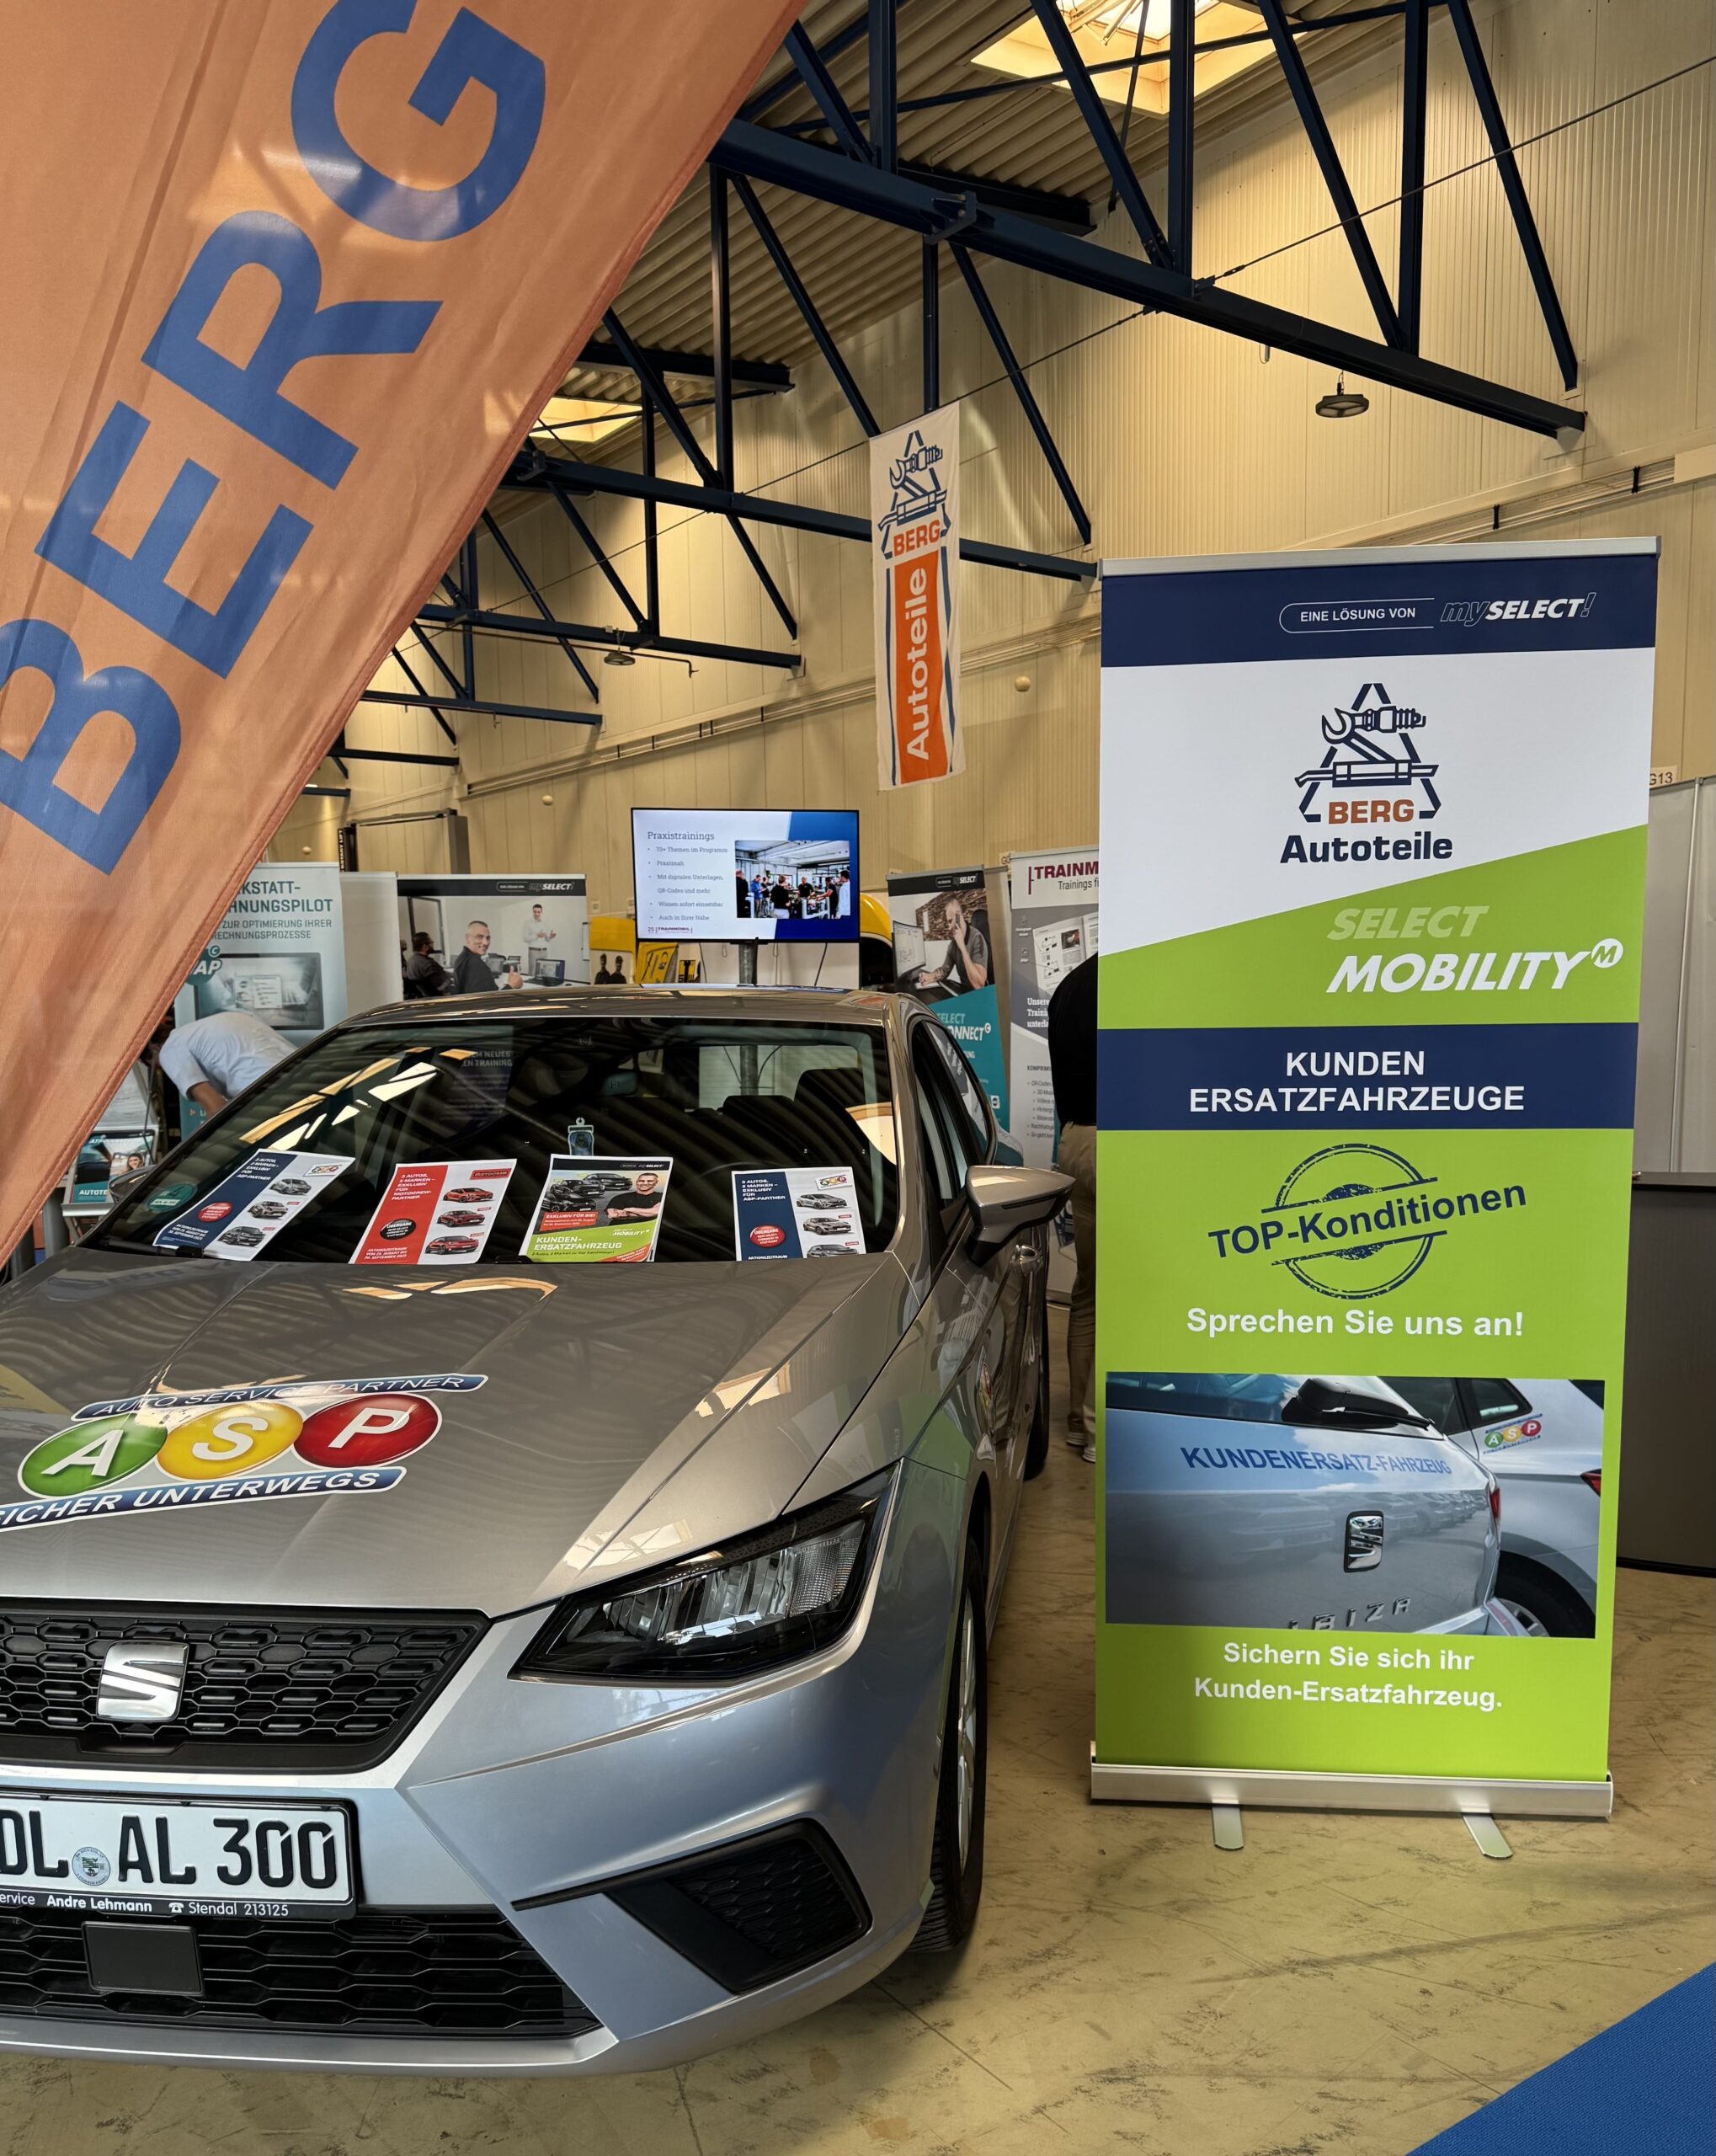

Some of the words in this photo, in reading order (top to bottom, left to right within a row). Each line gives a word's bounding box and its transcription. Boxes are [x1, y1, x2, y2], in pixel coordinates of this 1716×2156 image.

[0, 0, 546, 876] BERG
[893, 520, 941, 557] BERG
[1300, 611, 1329, 622] EINE
[1332, 608, 1386, 622] LÖSUNG
[1389, 607, 1416, 619] VON
[905, 566, 929, 760] Autoteile
[1328, 799, 1415, 825] BERG
[647, 831, 714, 841] Praxistrainings
[1281, 831, 1453, 864] Autoteile
[239, 881, 301, 894] KSTATT-
[1058, 879, 1092, 891] Trainings
[229, 899, 333, 913] HNUNGSPILOT
[213, 931, 312, 940] RECHNUNGSPROZESSE
[242, 920, 302, 928] OPTIMIERUNG
[305, 919, 332, 927] IHRER
[1327, 905, 1490, 940] SELECT
[1326, 951, 1592, 993] MOBILITY
[947, 1025, 984, 1041] ONNECT
[1286, 1050, 1426, 1078] KUNDEN
[1190, 1086, 1525, 1113] ERSATZFAHRZEUGE
[1207, 1180, 1527, 1259] TOP-Konditionen
[534, 1242, 622, 1251] ERSATZFAHRZEUG
[1186, 1307, 1333, 1340] Sprechen
[1345, 1308, 1395, 1337] Sie
[1404, 1314, 1463, 1337] uns
[1474, 1311, 1524, 1337] an!
[322, 1377, 464, 1394] PARTNER
[1180, 1447, 1452, 1476] KUNDENERSATZ-FAHRZEUG
[133, 1472, 380, 1507] UNTERWEGS
[1223, 1641, 1320, 1668] Sichern
[1329, 1645, 1370, 1668] Sie
[1377, 1646, 1431, 1669] sich
[1439, 1648, 1474, 1670] ihr
[1194, 1677, 1503, 1712] Kunden-Ersatzfahrzeug.
[118, 1816, 197, 1885] AL
[213, 1818, 337, 1889] 300
[0, 1892, 35, 1905] ervice
[46, 1895, 86, 1909] Andre
[90, 1897, 152, 1913] Lehmann
[189, 1902, 237, 1916] Stendal
[244, 1903, 289, 1917] 213125
